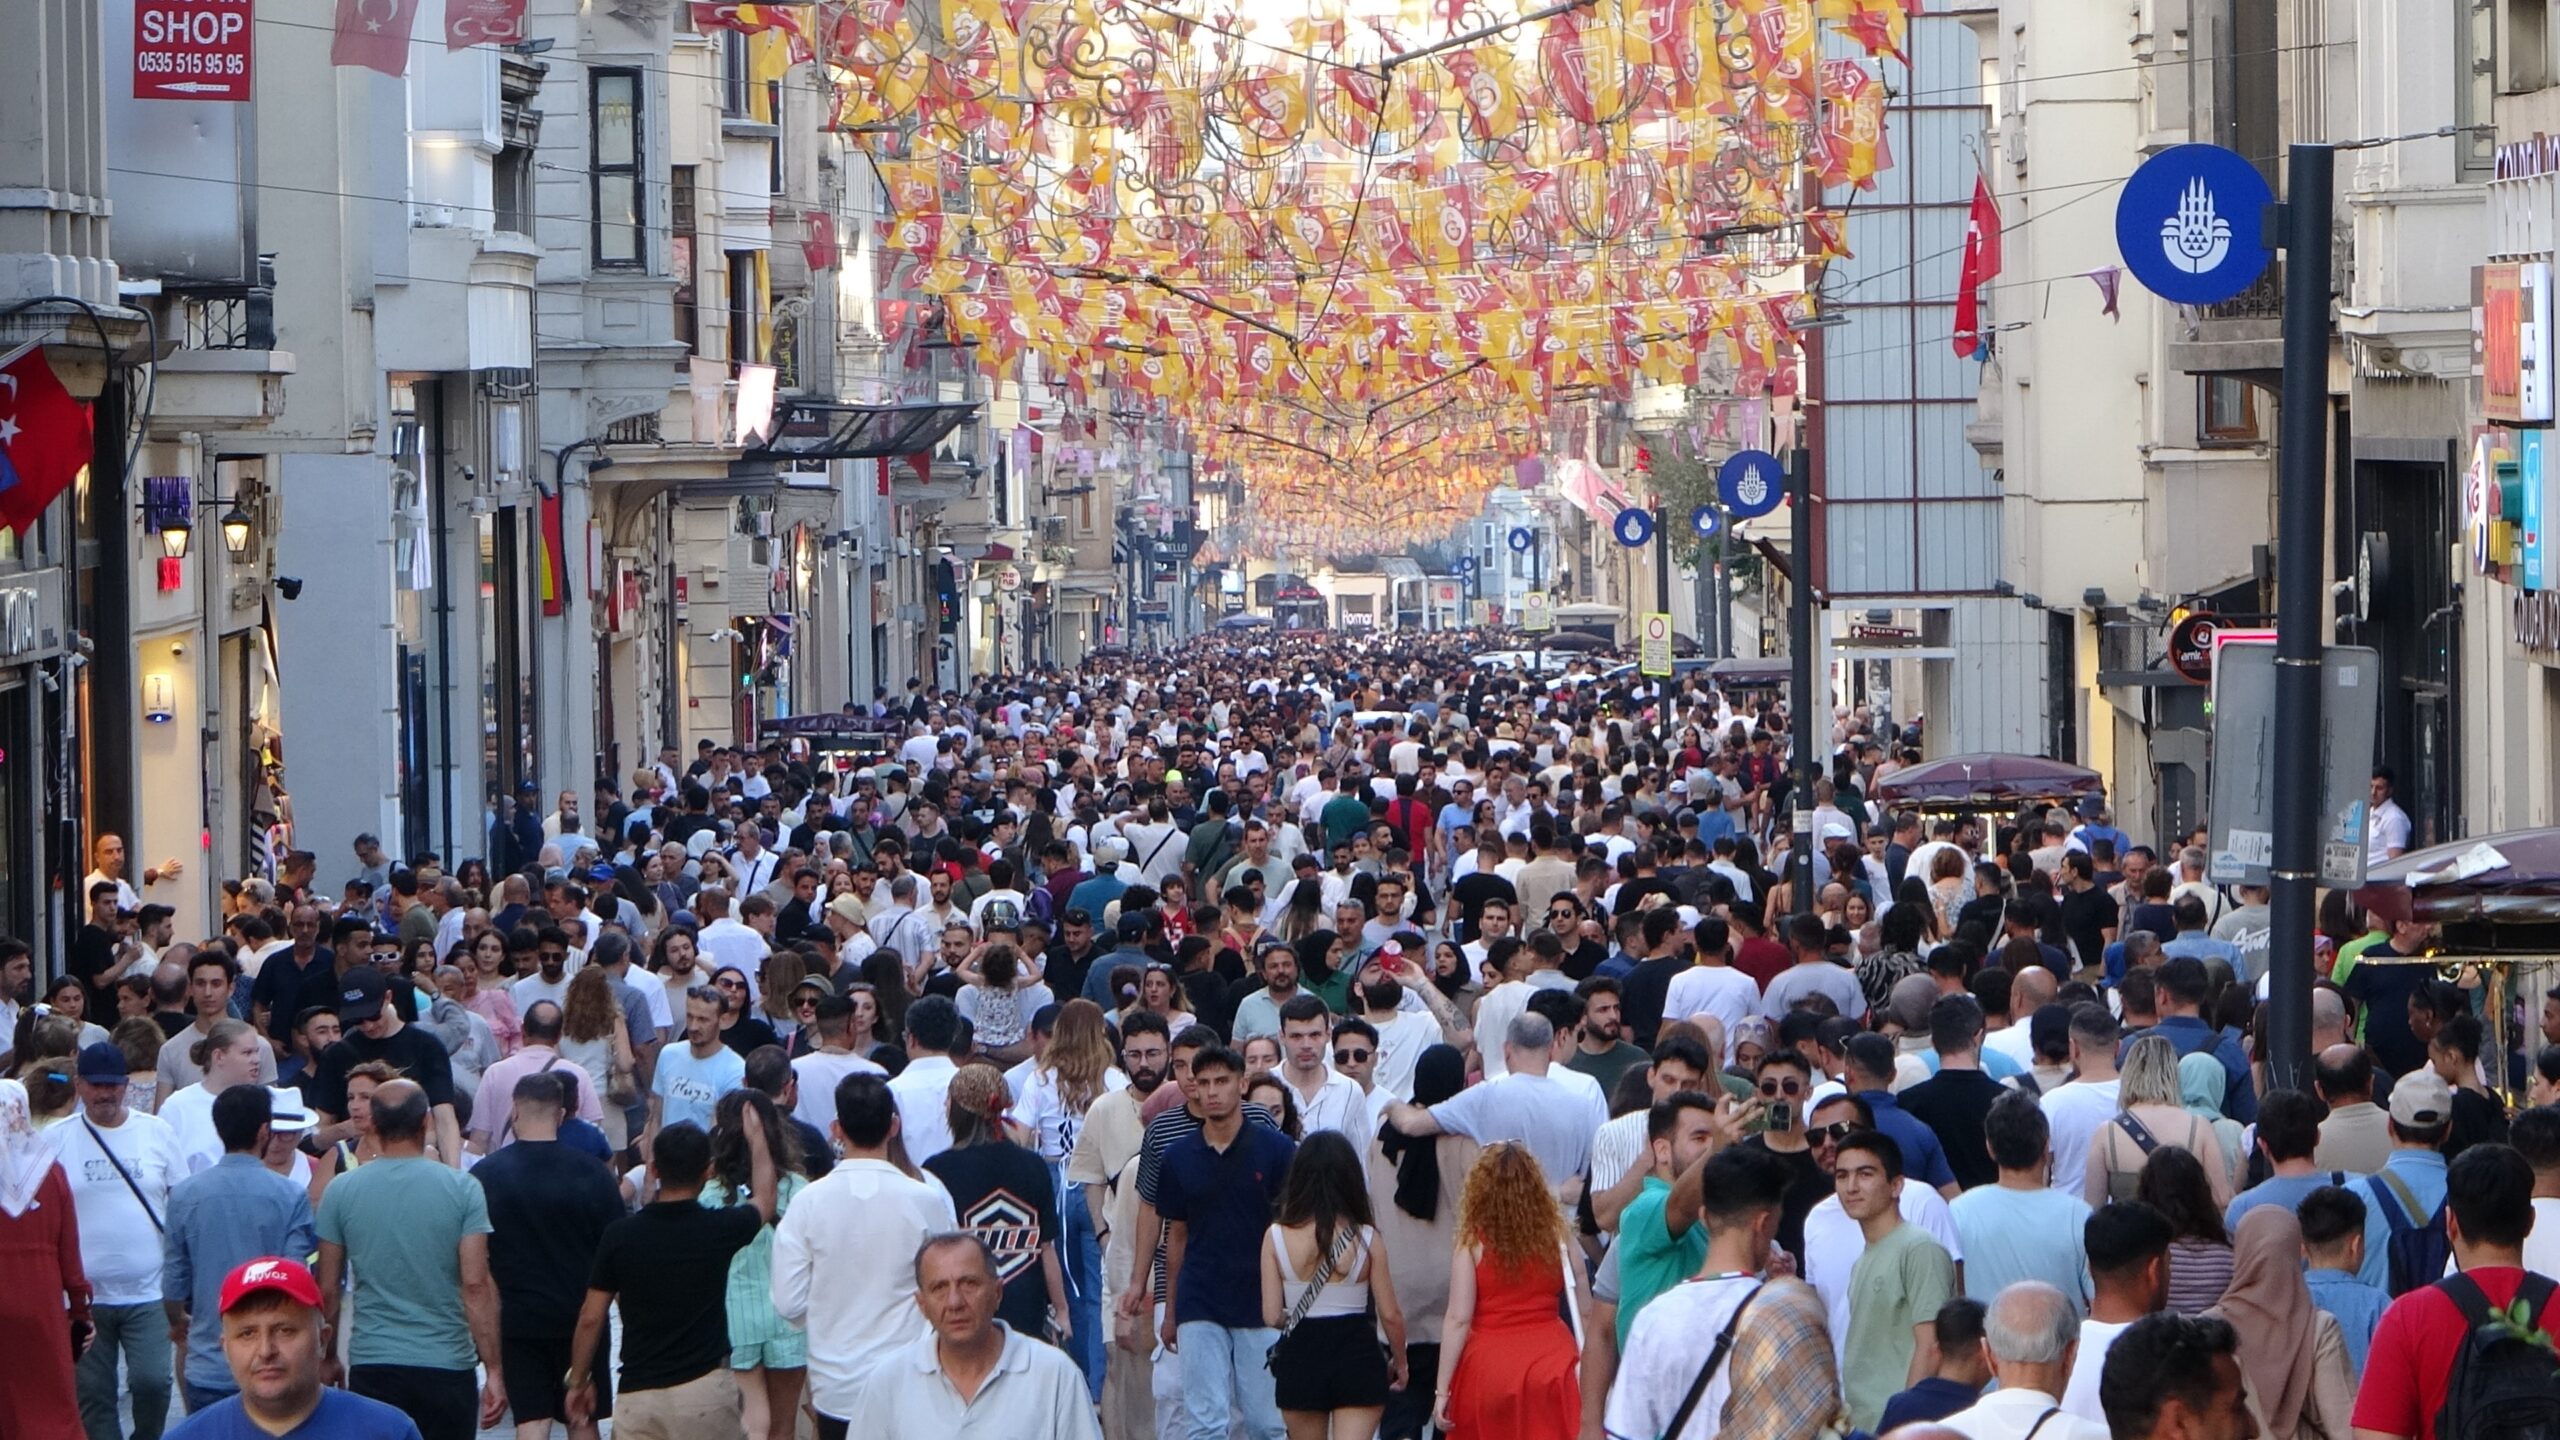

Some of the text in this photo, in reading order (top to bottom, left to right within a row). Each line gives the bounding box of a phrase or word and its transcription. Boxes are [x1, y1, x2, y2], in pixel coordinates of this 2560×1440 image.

[142, 10, 243, 44] SHOP
[139, 52, 244, 74] 0535 515 95 95
[672, 1076, 711, 1104] Hugo
